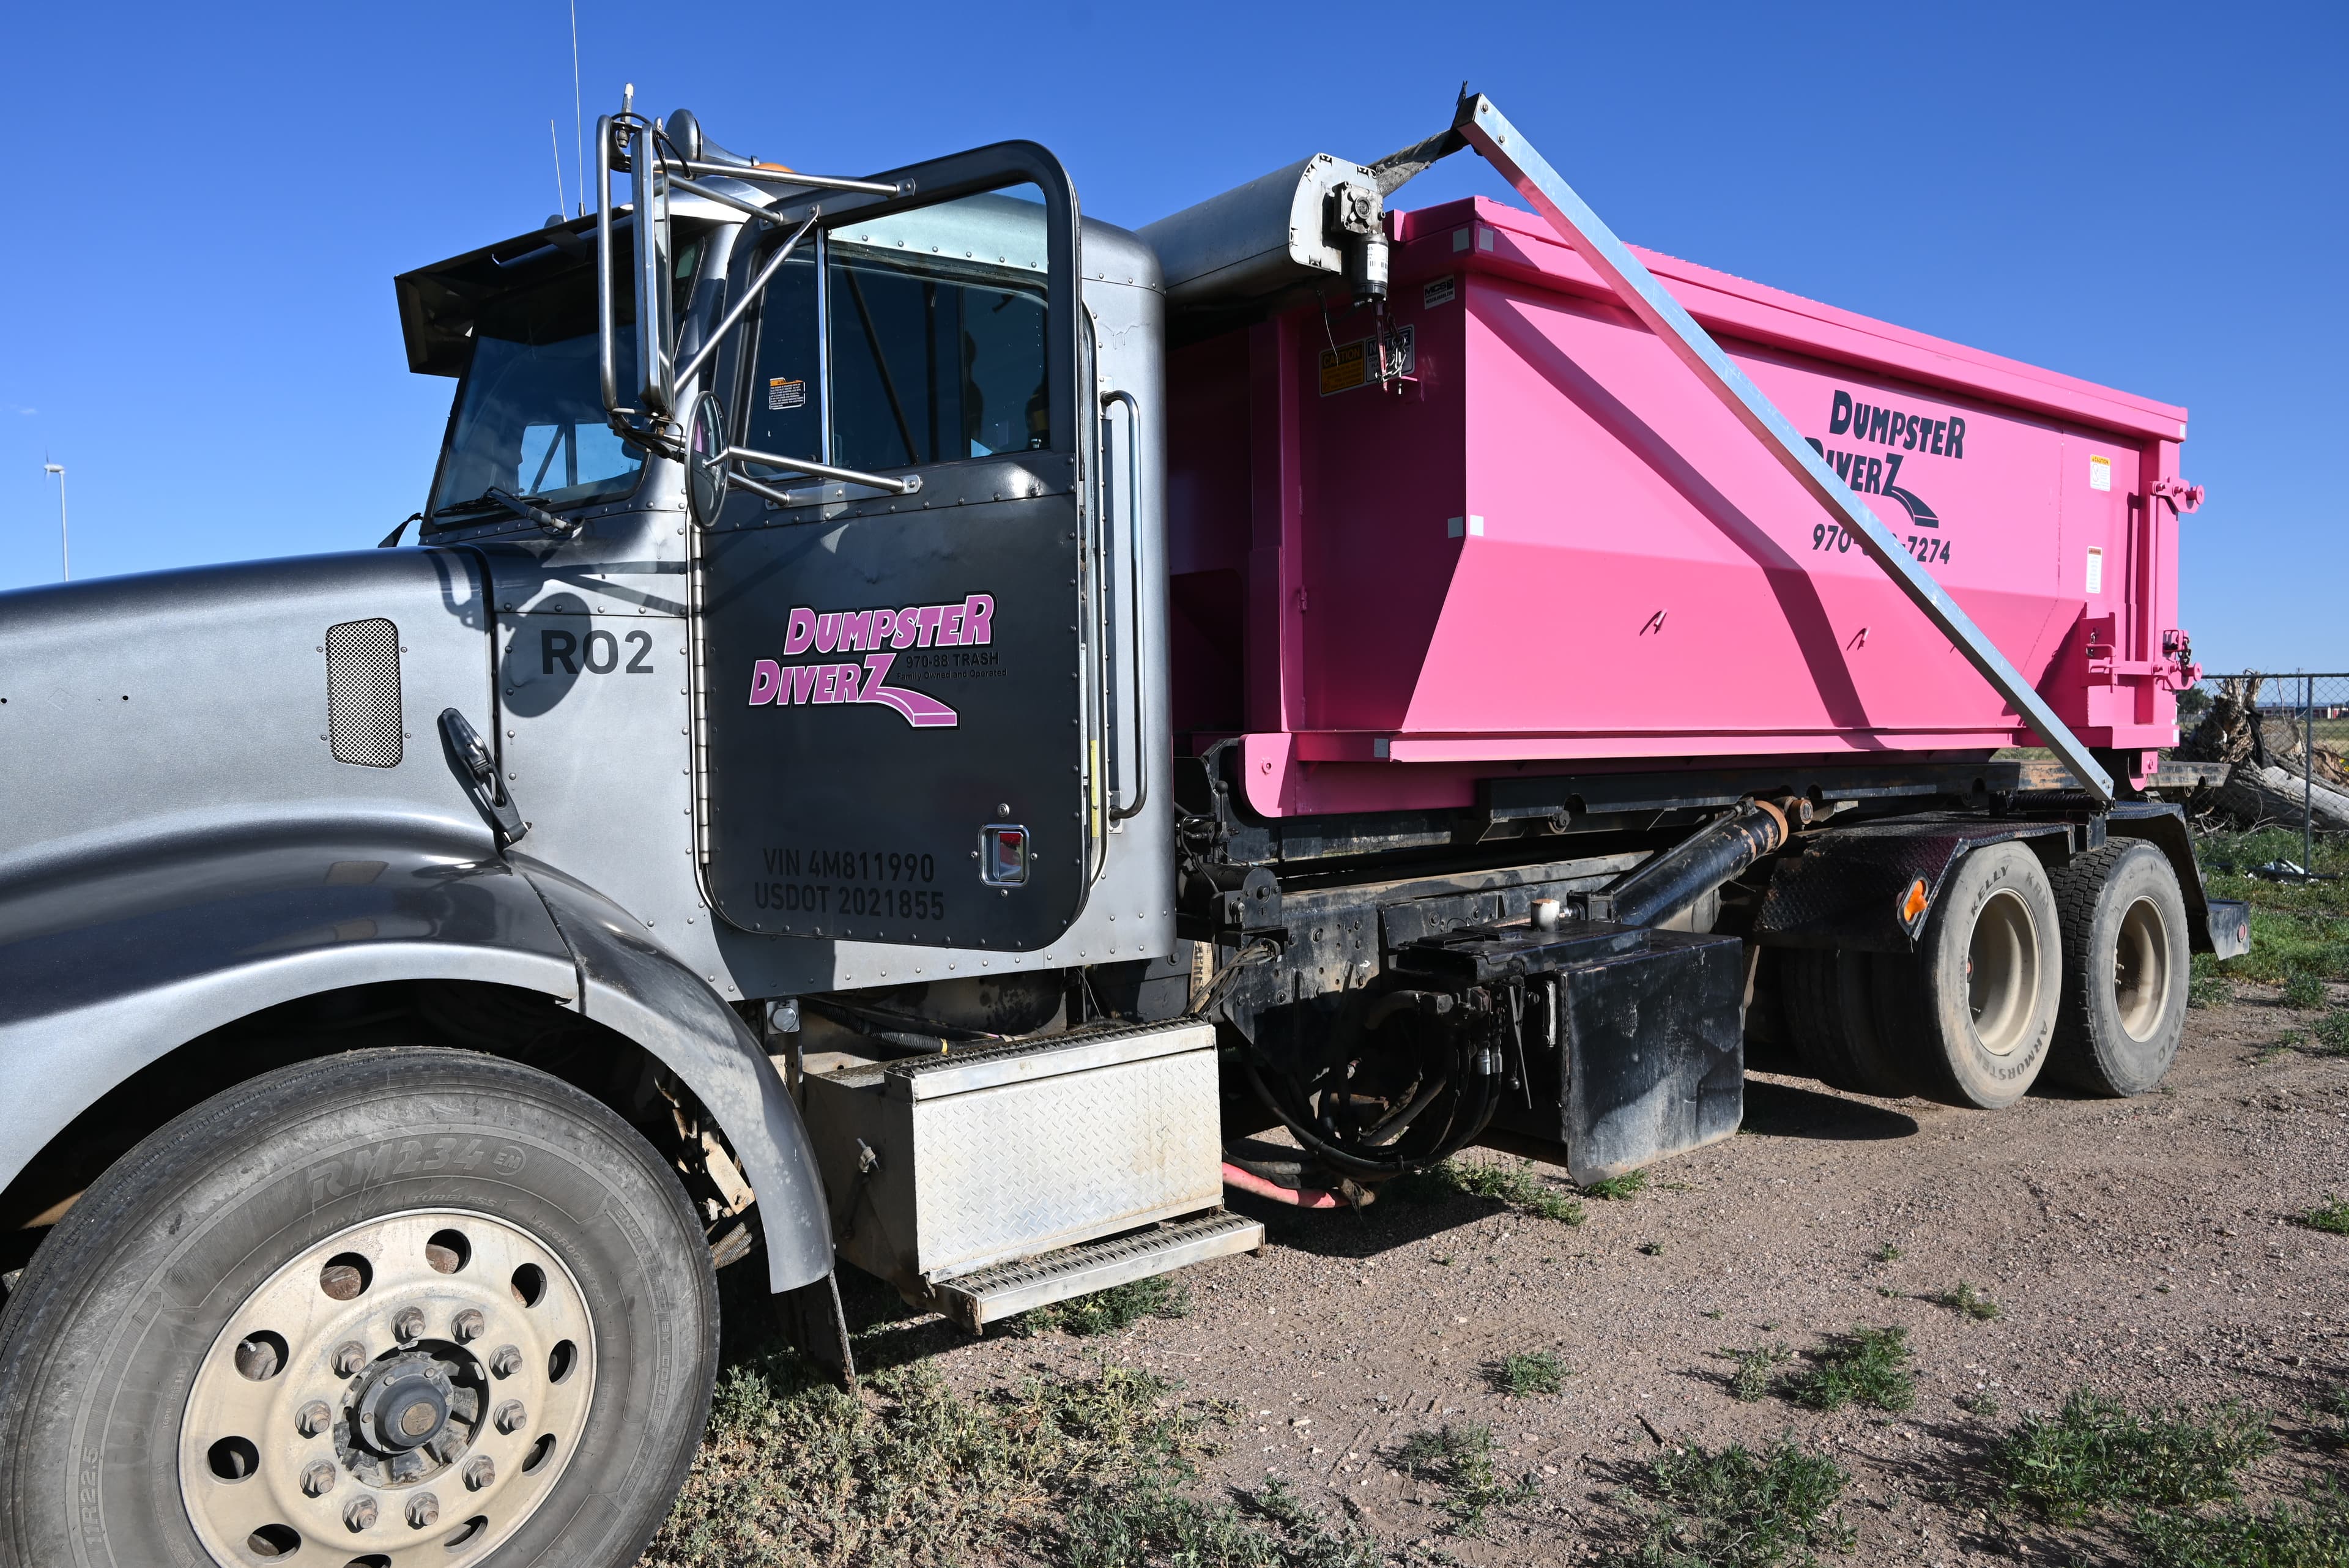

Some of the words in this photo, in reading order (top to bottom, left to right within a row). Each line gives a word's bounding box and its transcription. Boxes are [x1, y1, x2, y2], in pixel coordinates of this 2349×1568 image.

[1425, 281, 1446, 295] MCS
[1323, 347, 1361, 367] CAUTION
[1829, 390, 1965, 459] DUMPSTER
[2095, 456, 2109, 465] CAUTION
[783, 593, 995, 656] DUMPSTER
[897, 672, 922, 682] Family
[924, 670, 951, 680] Owned
[952, 669, 968, 679] and
[970, 669, 1008, 678] Operated
[906, 655, 948, 669] 970-88
[952, 651, 1000, 666] TRASH
[749, 653, 918, 713] DIVERZ
[762, 848, 800, 877] VIN
[807, 852, 936, 883] 4M811990
[754, 882, 831, 913] USDOT
[838, 885, 946, 921] 2021855
[1970, 864, 2010, 919] KELLY
[310, 1137, 486, 1203] RM234
[493, 1151, 522, 1171] EM
[410, 1193, 499, 1208] TUBELESS
[80, 1446, 103, 1545] 11R22.5
